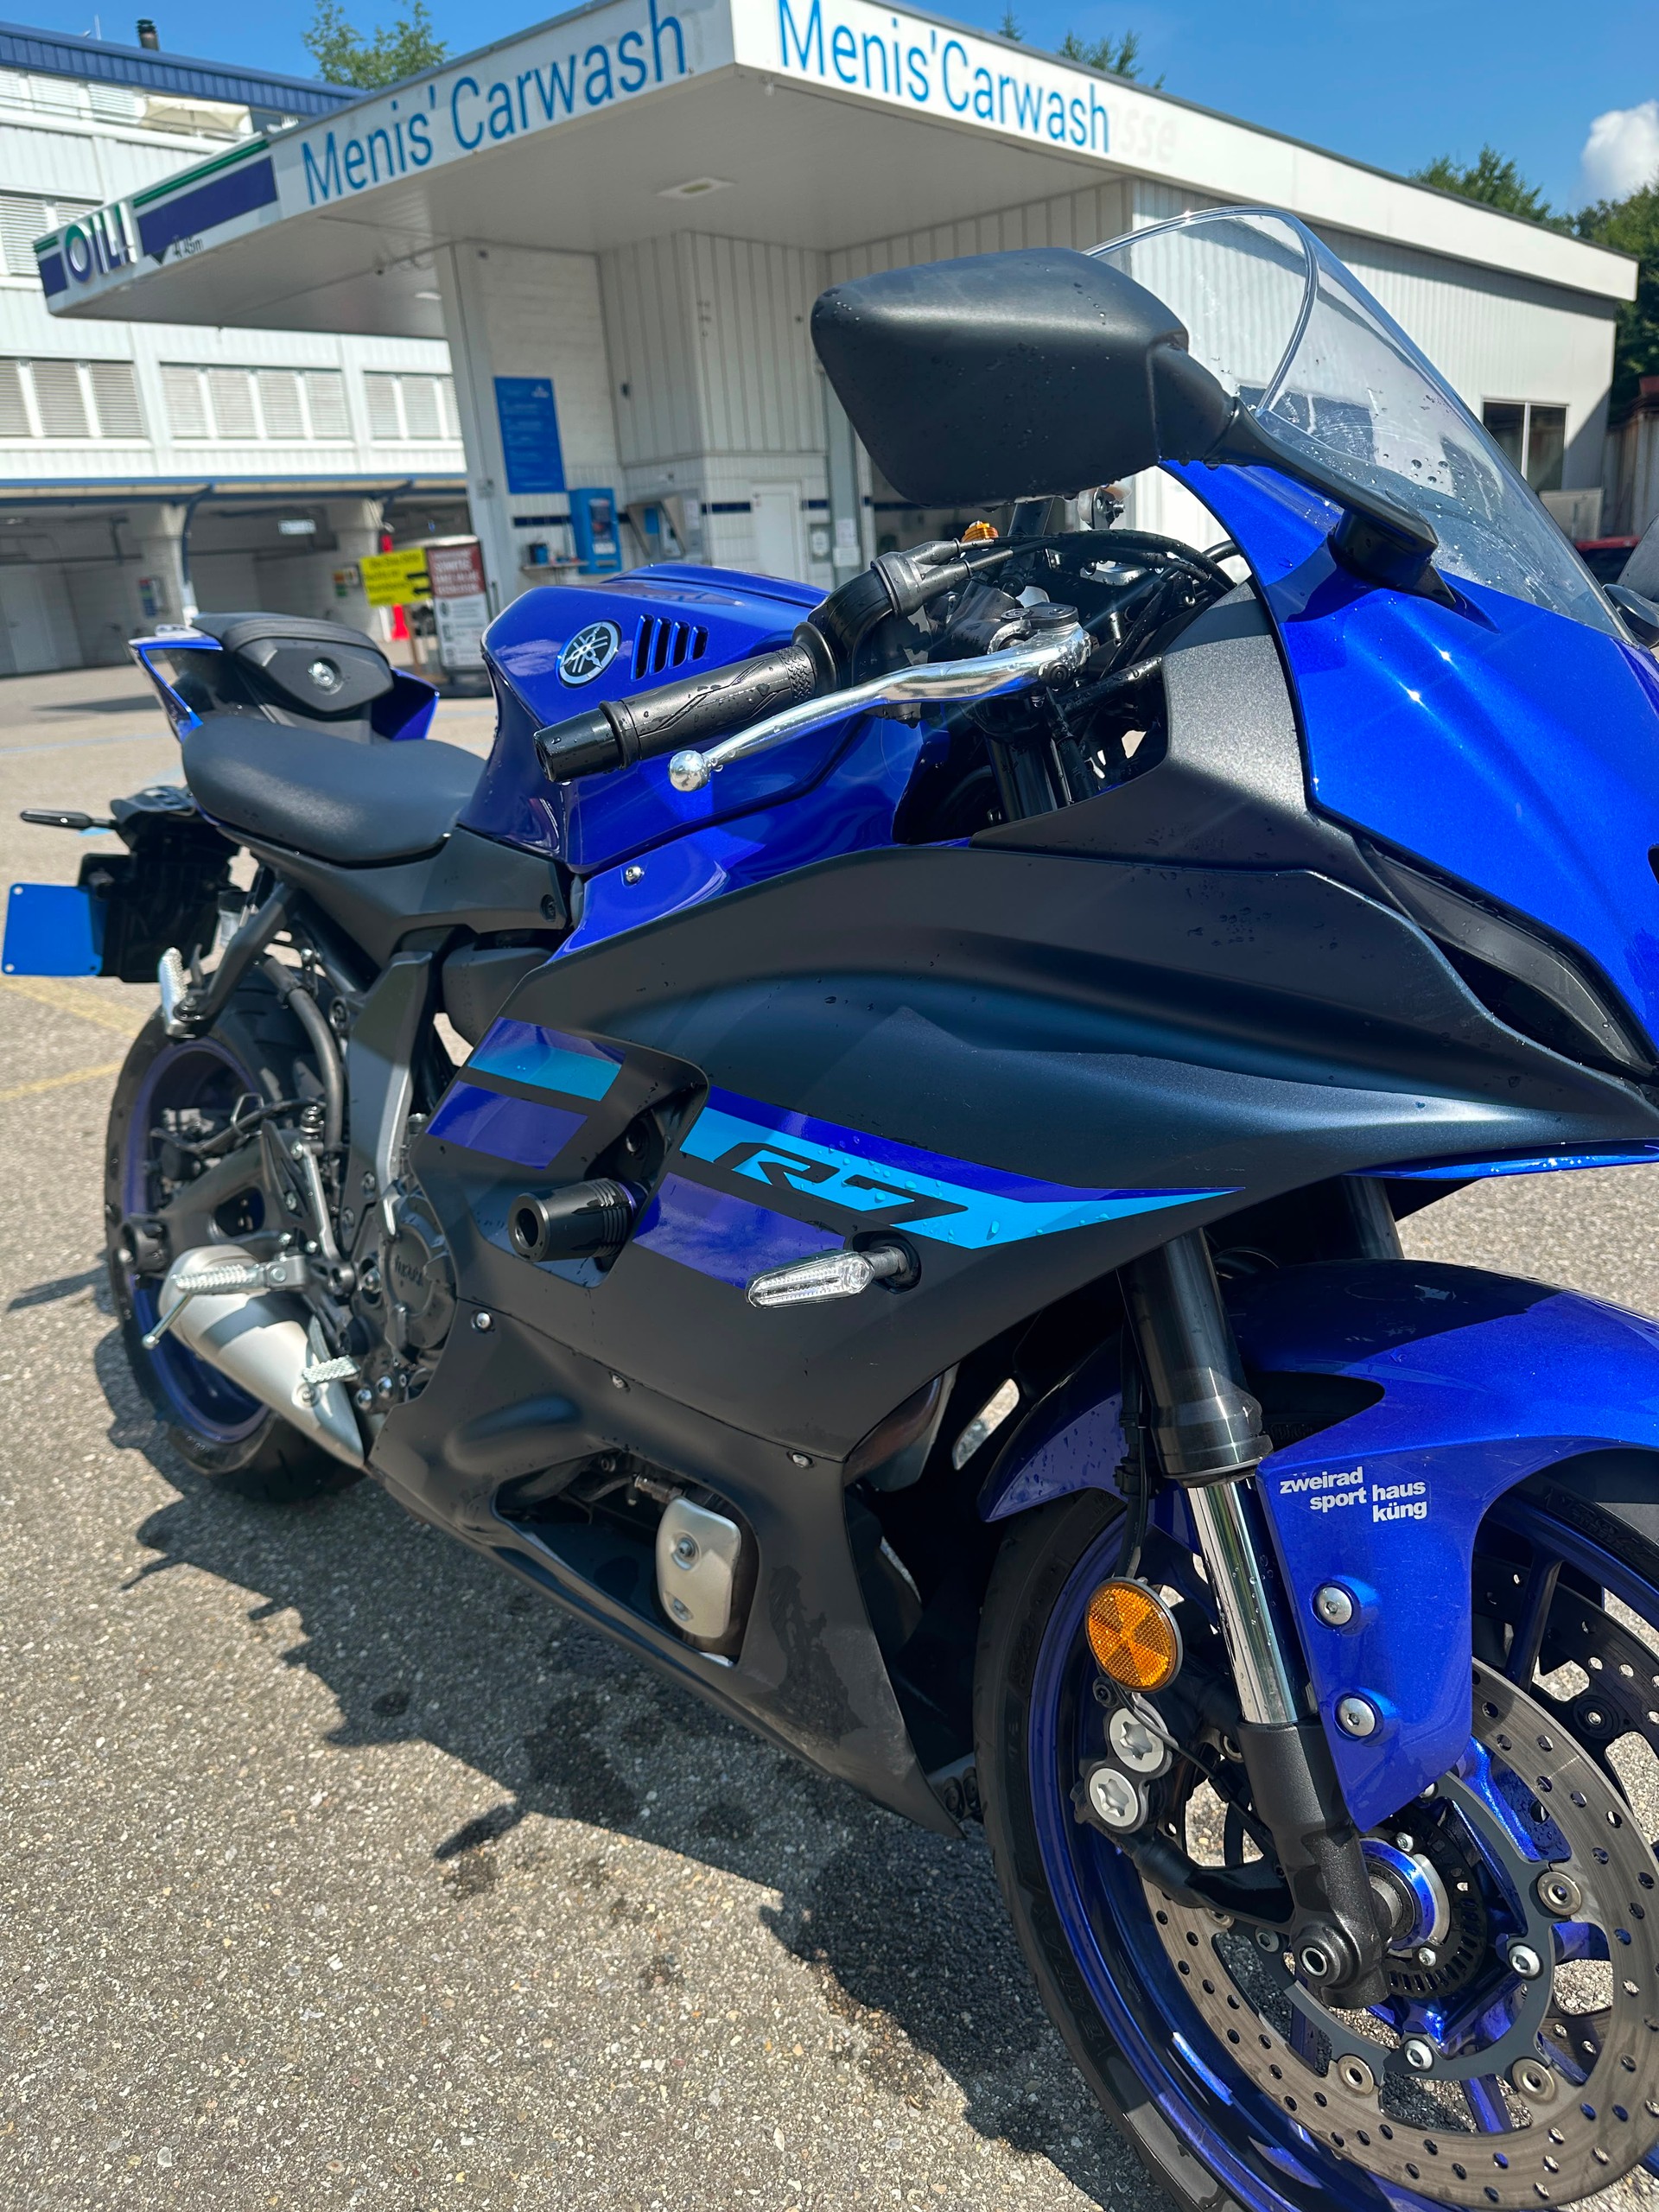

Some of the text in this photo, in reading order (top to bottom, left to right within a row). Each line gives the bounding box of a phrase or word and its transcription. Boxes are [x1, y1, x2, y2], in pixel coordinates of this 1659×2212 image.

[779, 0, 1109, 154] Menis' Carwash
[301, 0, 688, 206] Menis' Carwash
[1280, 1466, 1363, 1494] zweirad
[1310, 1481, 1427, 1513] sport haus
[1372, 1501, 1427, 1522] küng
